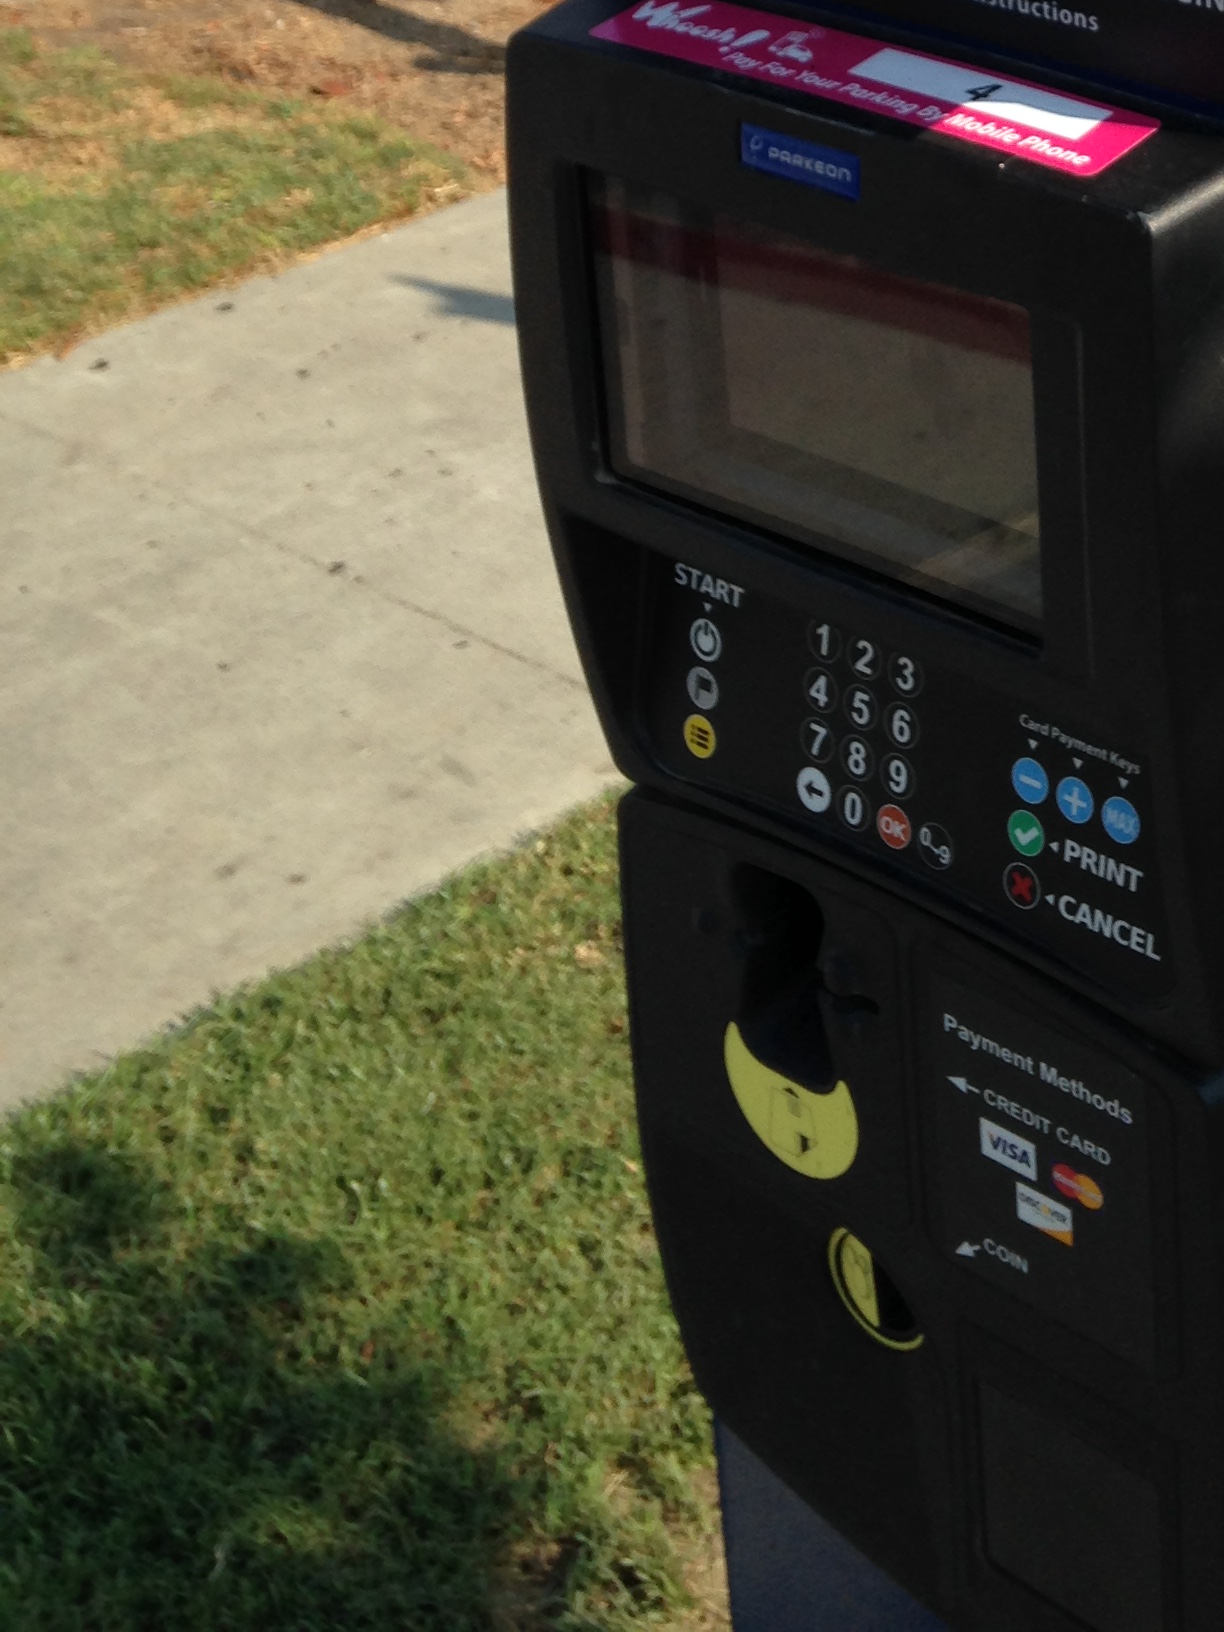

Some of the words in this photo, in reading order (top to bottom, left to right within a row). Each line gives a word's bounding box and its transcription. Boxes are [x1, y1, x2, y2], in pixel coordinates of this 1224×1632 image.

[632, 0, 770, 53] Whoosh!
[723, 51, 757, 70] Pay
[759, 61, 795, 78] For
[795, 69, 842, 90] Your
[839, 82, 919, 116] Parking
[918, 104, 942, 123] By
[943, 113, 1018, 144] Mobile
[1017, 135, 1091, 165] Phone
[965, 84, 1003, 102] 4
[674, 563, 744, 608] START
[815, 623, 830, 655] 1
[856, 641, 873, 674] 2
[897, 658, 915, 691] 3
[809, 675, 828, 706] 4
[852, 691, 869, 724] 5
[892, 709, 911, 743] 6
[810, 724, 828, 757] 7
[849, 741, 866, 775] 8
[889, 759, 907, 793] 9
[1019, 714, 1049, 737] Card
[1051, 725, 1108, 761] Payment
[1109, 745, 1141, 775] Keys
[845, 792, 862, 826] 0
[881, 816, 907, 841] OK
[1063, 839, 1143, 893] PRINT
[1057, 894, 1161, 961] CANCEL
[943, 1013, 1034, 1075] Payment
[1039, 1062, 1133, 1124] Methods
[983, 1088, 1050, 1135] CREDIT
[1056, 1127, 1112, 1166] CARD
[989, 1133, 1032, 1168] VISA
[983, 1238, 1028, 1273] COIN
